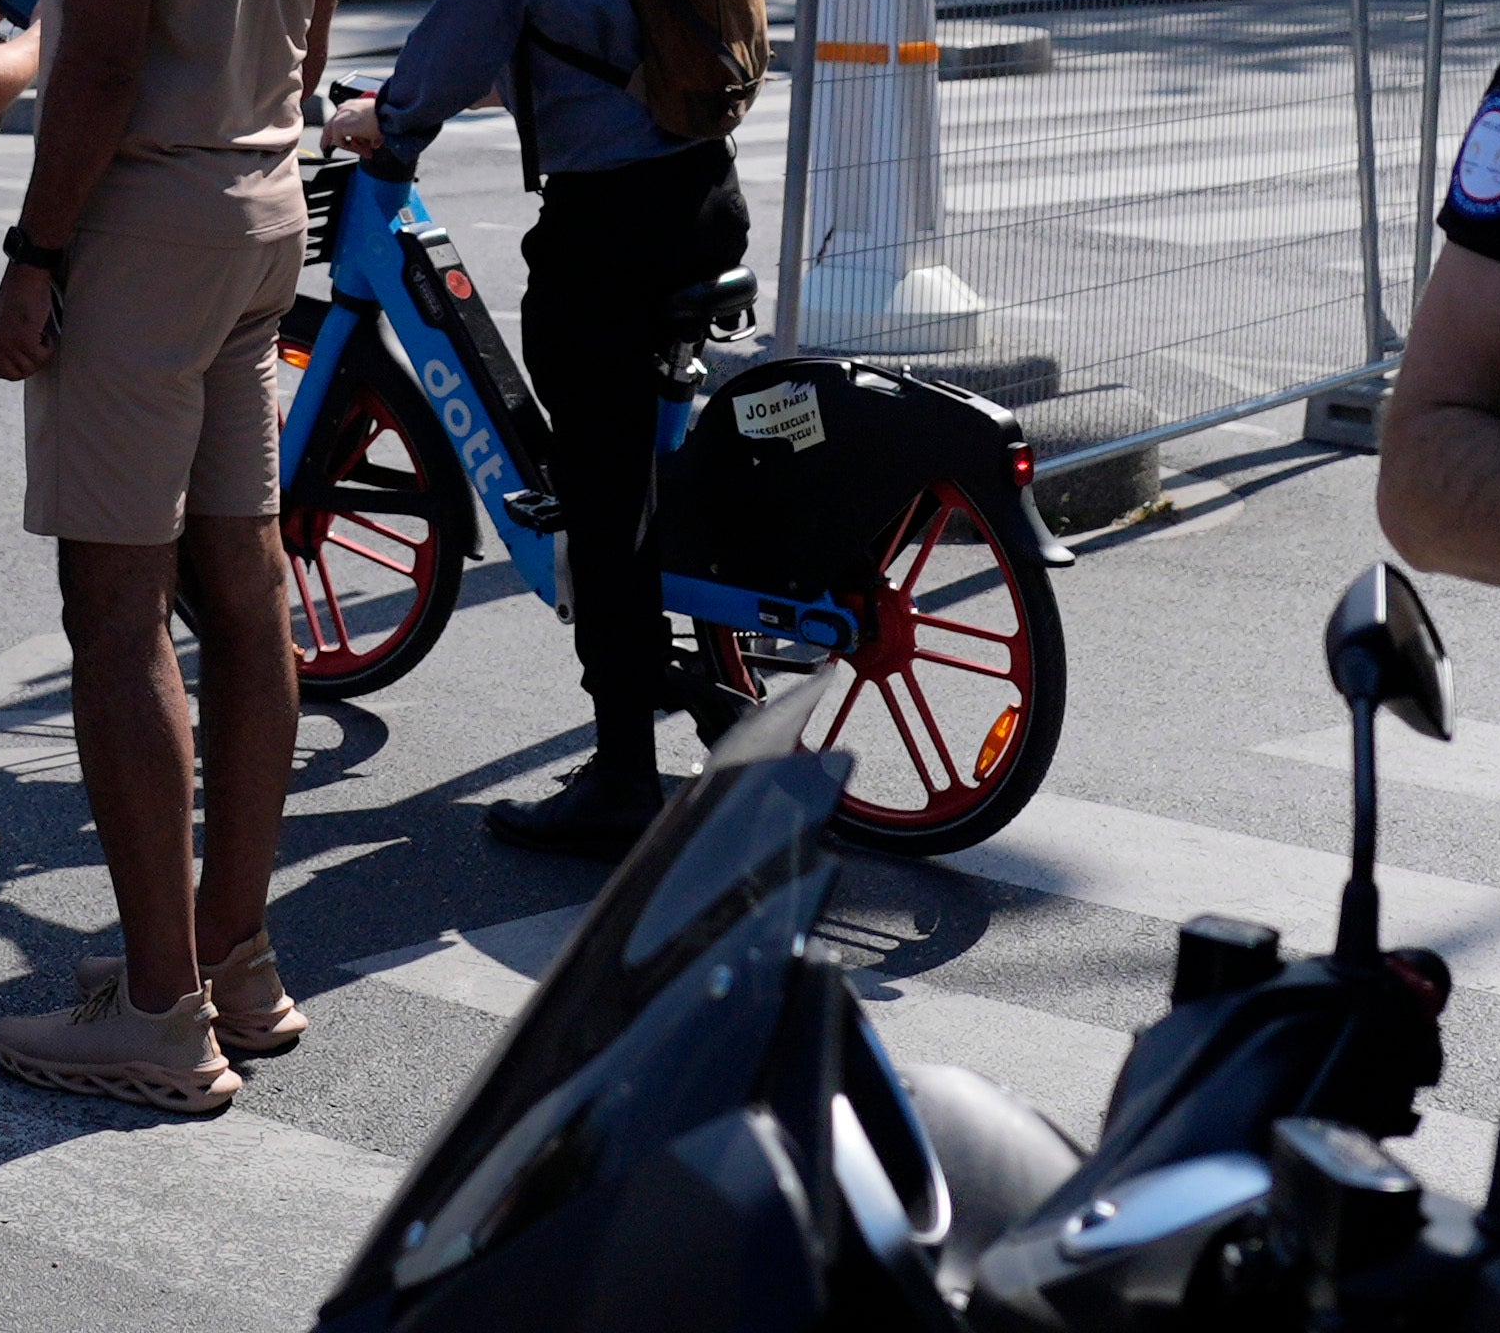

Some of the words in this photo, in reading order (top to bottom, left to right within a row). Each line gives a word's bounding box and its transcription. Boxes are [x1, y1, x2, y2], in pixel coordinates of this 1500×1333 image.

[746, 403, 767, 420] JO
[769, 401, 782, 415] DE
[783, 391, 809, 409] PARIS
[424, 359, 504, 495] dott
[780, 413, 811, 432] EXCLUE
[787, 428, 812, 442] XCLU
